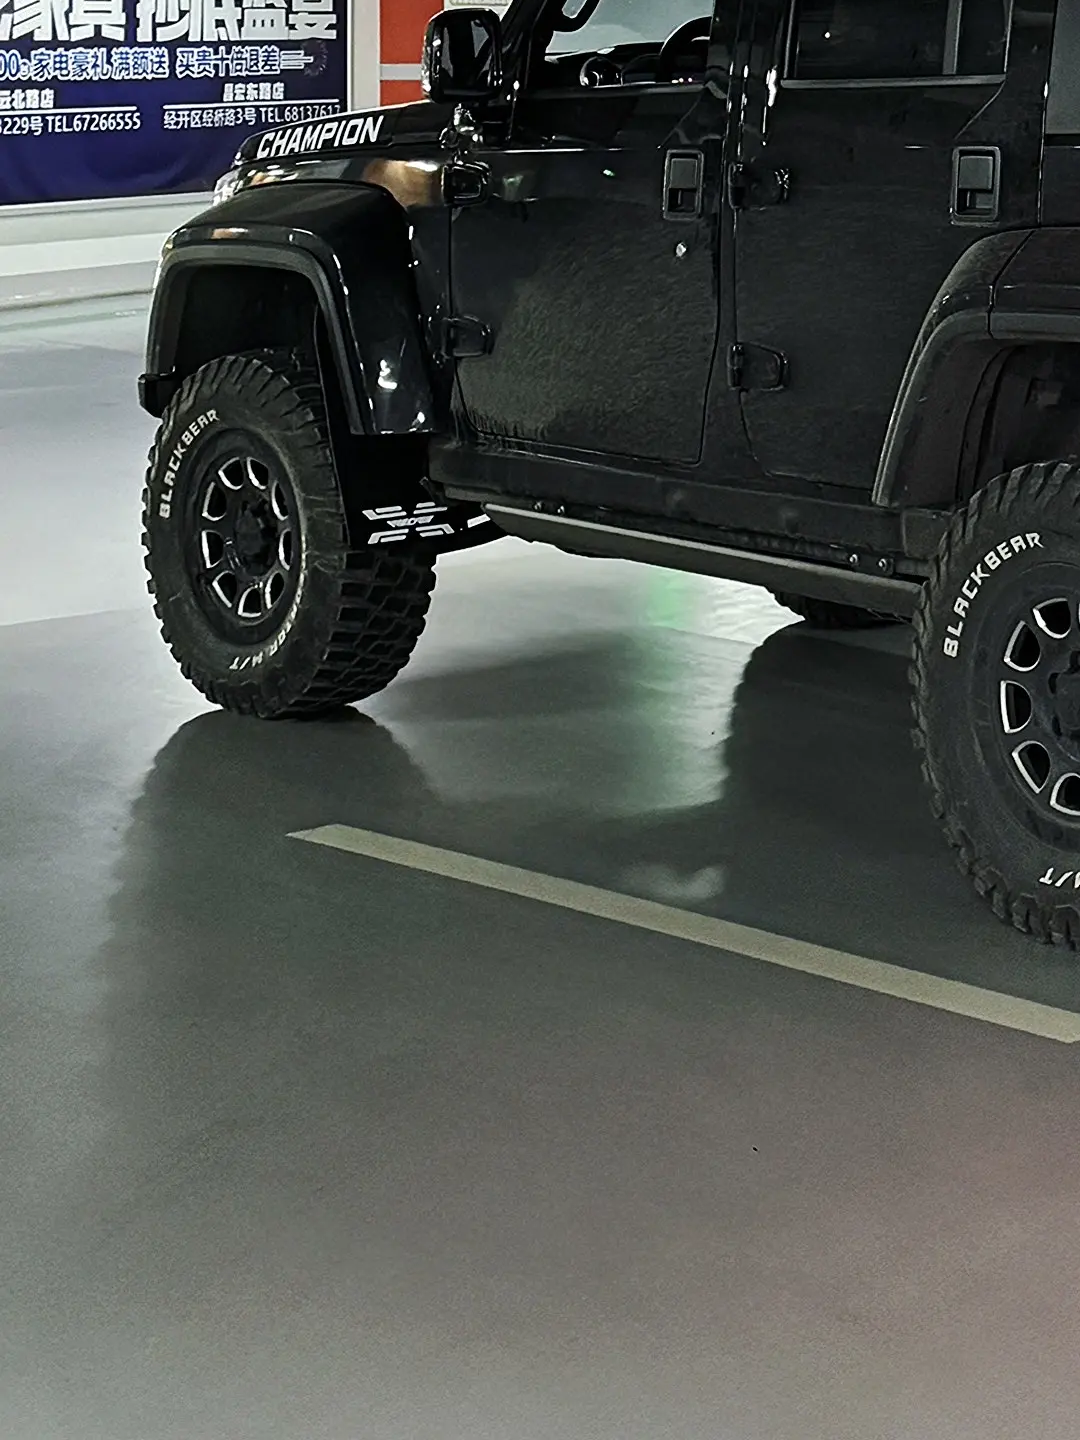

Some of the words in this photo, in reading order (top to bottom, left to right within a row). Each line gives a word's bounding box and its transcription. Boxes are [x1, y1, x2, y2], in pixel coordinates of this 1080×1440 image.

[0, 115, 43, 136] 229号
[257, 115, 384, 160] CHAMPION
[159, 409, 220, 518] BLACKBEAR
[943, 532, 1045, 657] BLACKBEAR
